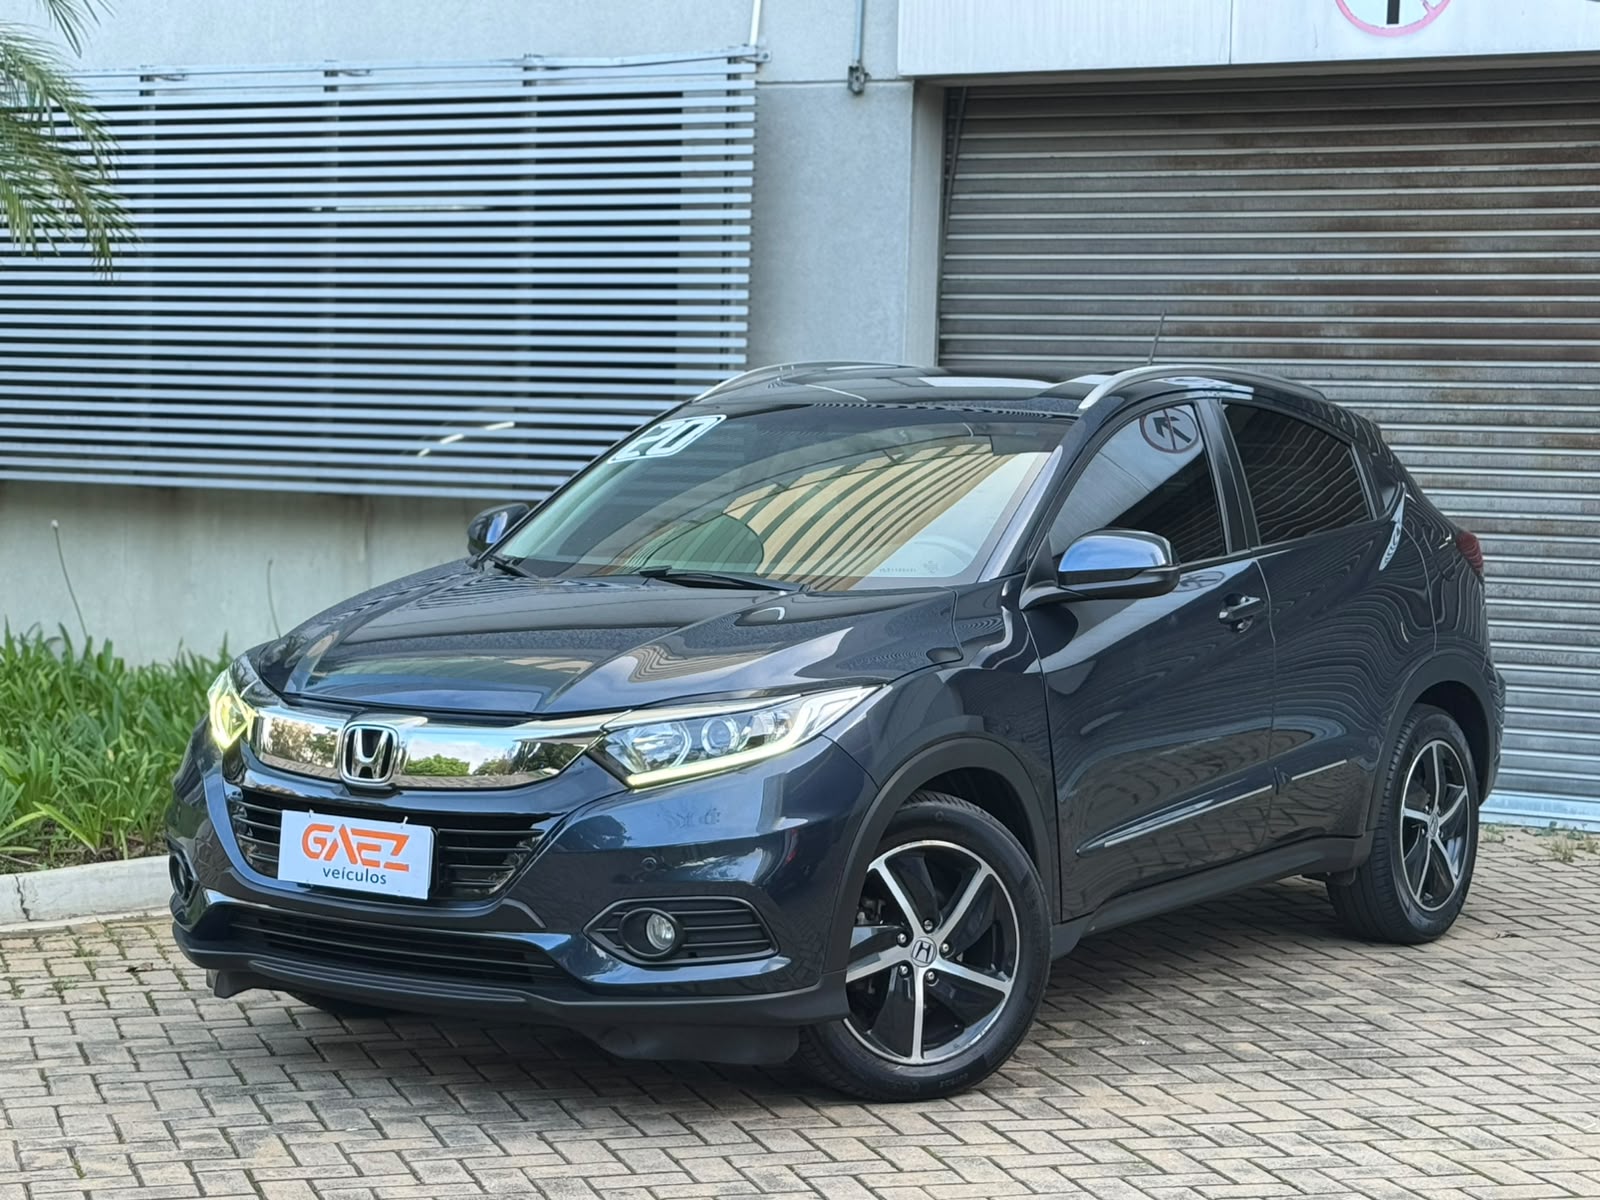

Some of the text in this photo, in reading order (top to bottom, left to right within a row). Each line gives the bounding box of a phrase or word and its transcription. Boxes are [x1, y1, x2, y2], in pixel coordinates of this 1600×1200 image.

[612, 416, 721, 462] 20
[302, 823, 409, 872] GAEZ
[322, 866, 387, 885] veículos
